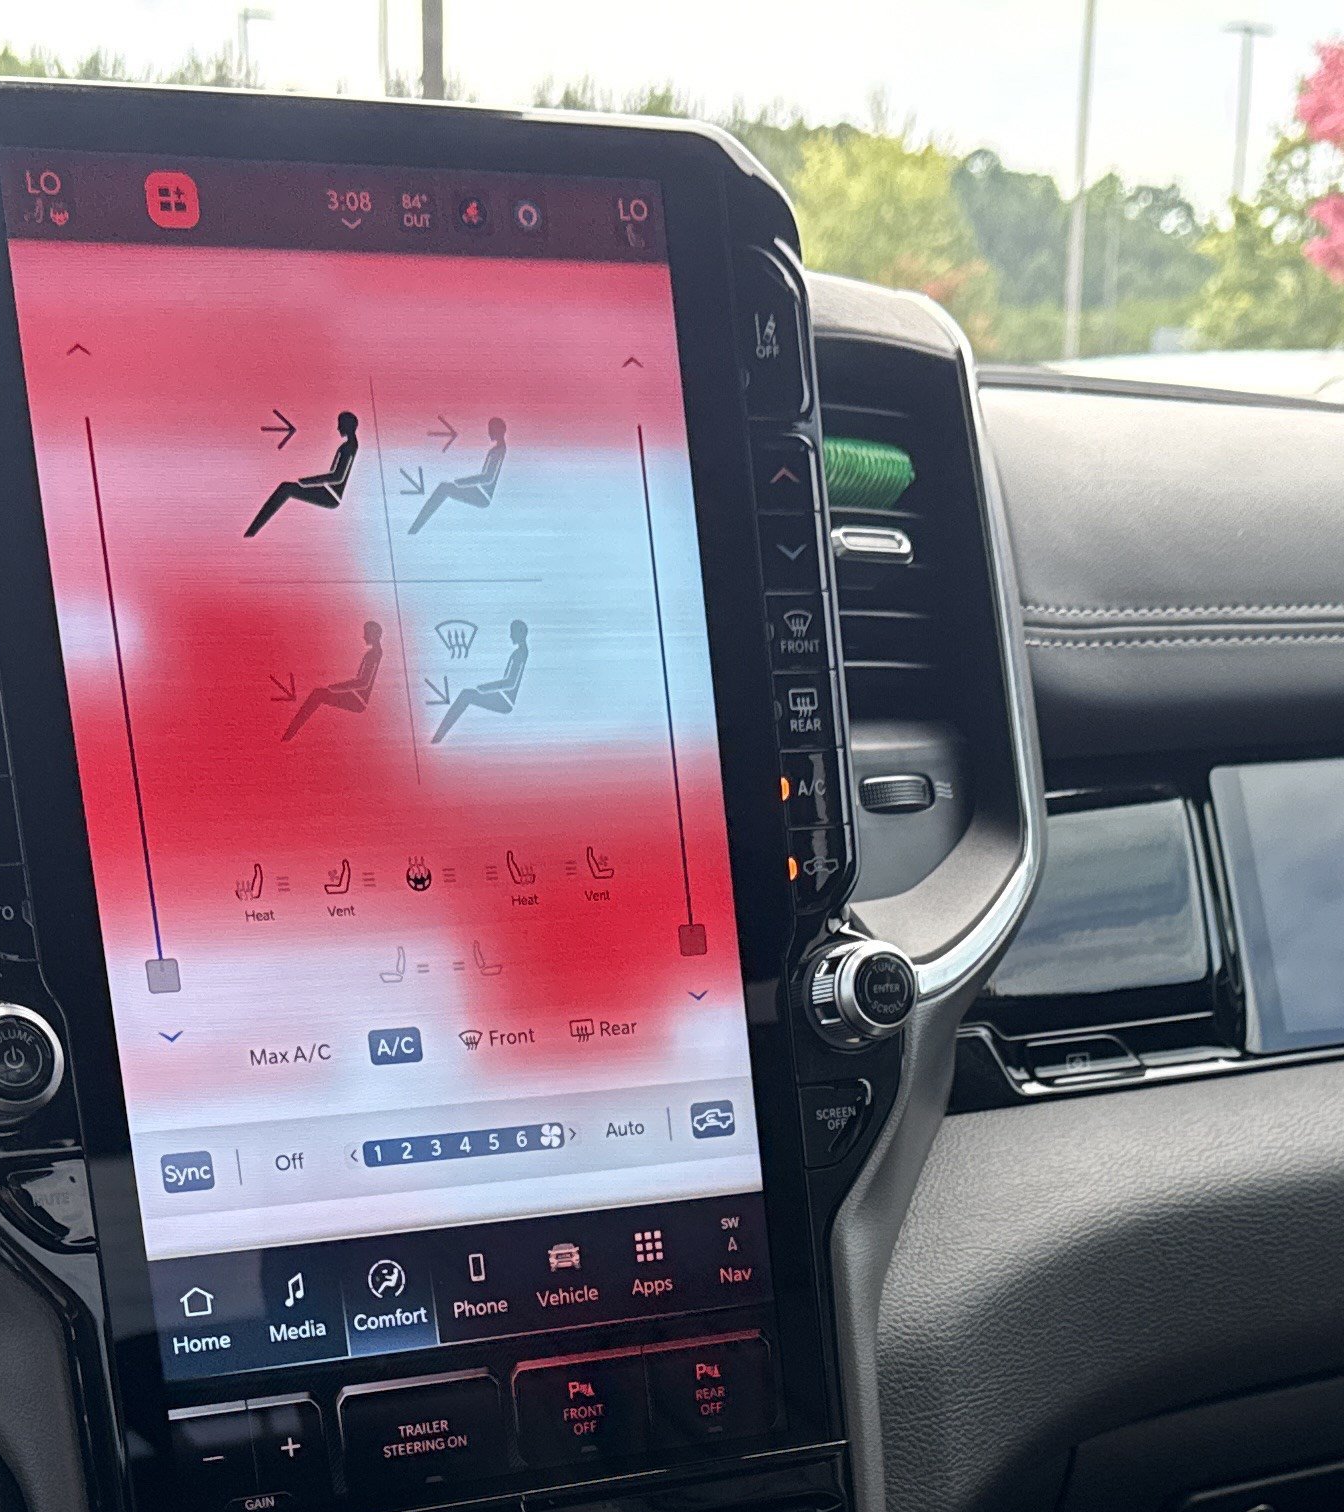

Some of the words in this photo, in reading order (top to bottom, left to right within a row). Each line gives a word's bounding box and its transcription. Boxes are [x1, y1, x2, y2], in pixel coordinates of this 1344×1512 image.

[25, 170, 61, 195] LO
[328, 189, 372, 212] 3:08
[618, 199, 647, 221] LO
[403, 213, 431, 228] OUT
[756, 345, 779, 358] OFF
[780, 639, 820, 654] FRONT
[790, 719, 822, 733] REAR
[798, 779, 826, 796] A/C
[511, 894, 539, 907] Heat
[584, 889, 610, 902] Vent
[245, 909, 275, 922] Heat
[327, 905, 355, 918] Vent
[873, 983, 900, 994] ENTER
[489, 1027, 535, 1048] Front
[599, 1020, 637, 1038] Rear
[250, 1047, 290, 1067] Max
[293, 1043, 332, 1064] A/C
[377, 1037, 415, 1057] A/C
[816, 1106, 856, 1120] SCREEN
[605, 1120, 645, 1139] Auto
[827, 1118, 848, 1130] OFF
[374, 1146, 383, 1162] 1
[401, 1142, 413, 1161] 2
[430, 1139, 442, 1158] 3
[459, 1136, 472, 1154] 4
[488, 1133, 500, 1151] 5
[516, 1130, 528, 1148] 6
[275, 1153, 304, 1172] Off
[164, 1163, 211, 1185] Sync
[720, 1217, 739, 1230] SW
[719, 1265, 752, 1284] Nav
[631, 1275, 673, 1298] Apps
[536, 1284, 599, 1309] Vehicle
[453, 1295, 508, 1319] Phone
[354, 1306, 428, 1333] Comfort
[269, 1318, 327, 1343] Media
[173, 1331, 232, 1356] Home
[695, 1386, 725, 1402] REAR
[563, 1403, 604, 1421] FRONT
[700, 1401, 722, 1416] OFF
[398, 1420, 449, 1437] TRAILER
[573, 1420, 597, 1435] OFF
[383, 1438, 445, 1459] STEERING
[447, 1435, 468, 1449] ON
[245, 1496, 275, 1510] GAIN
